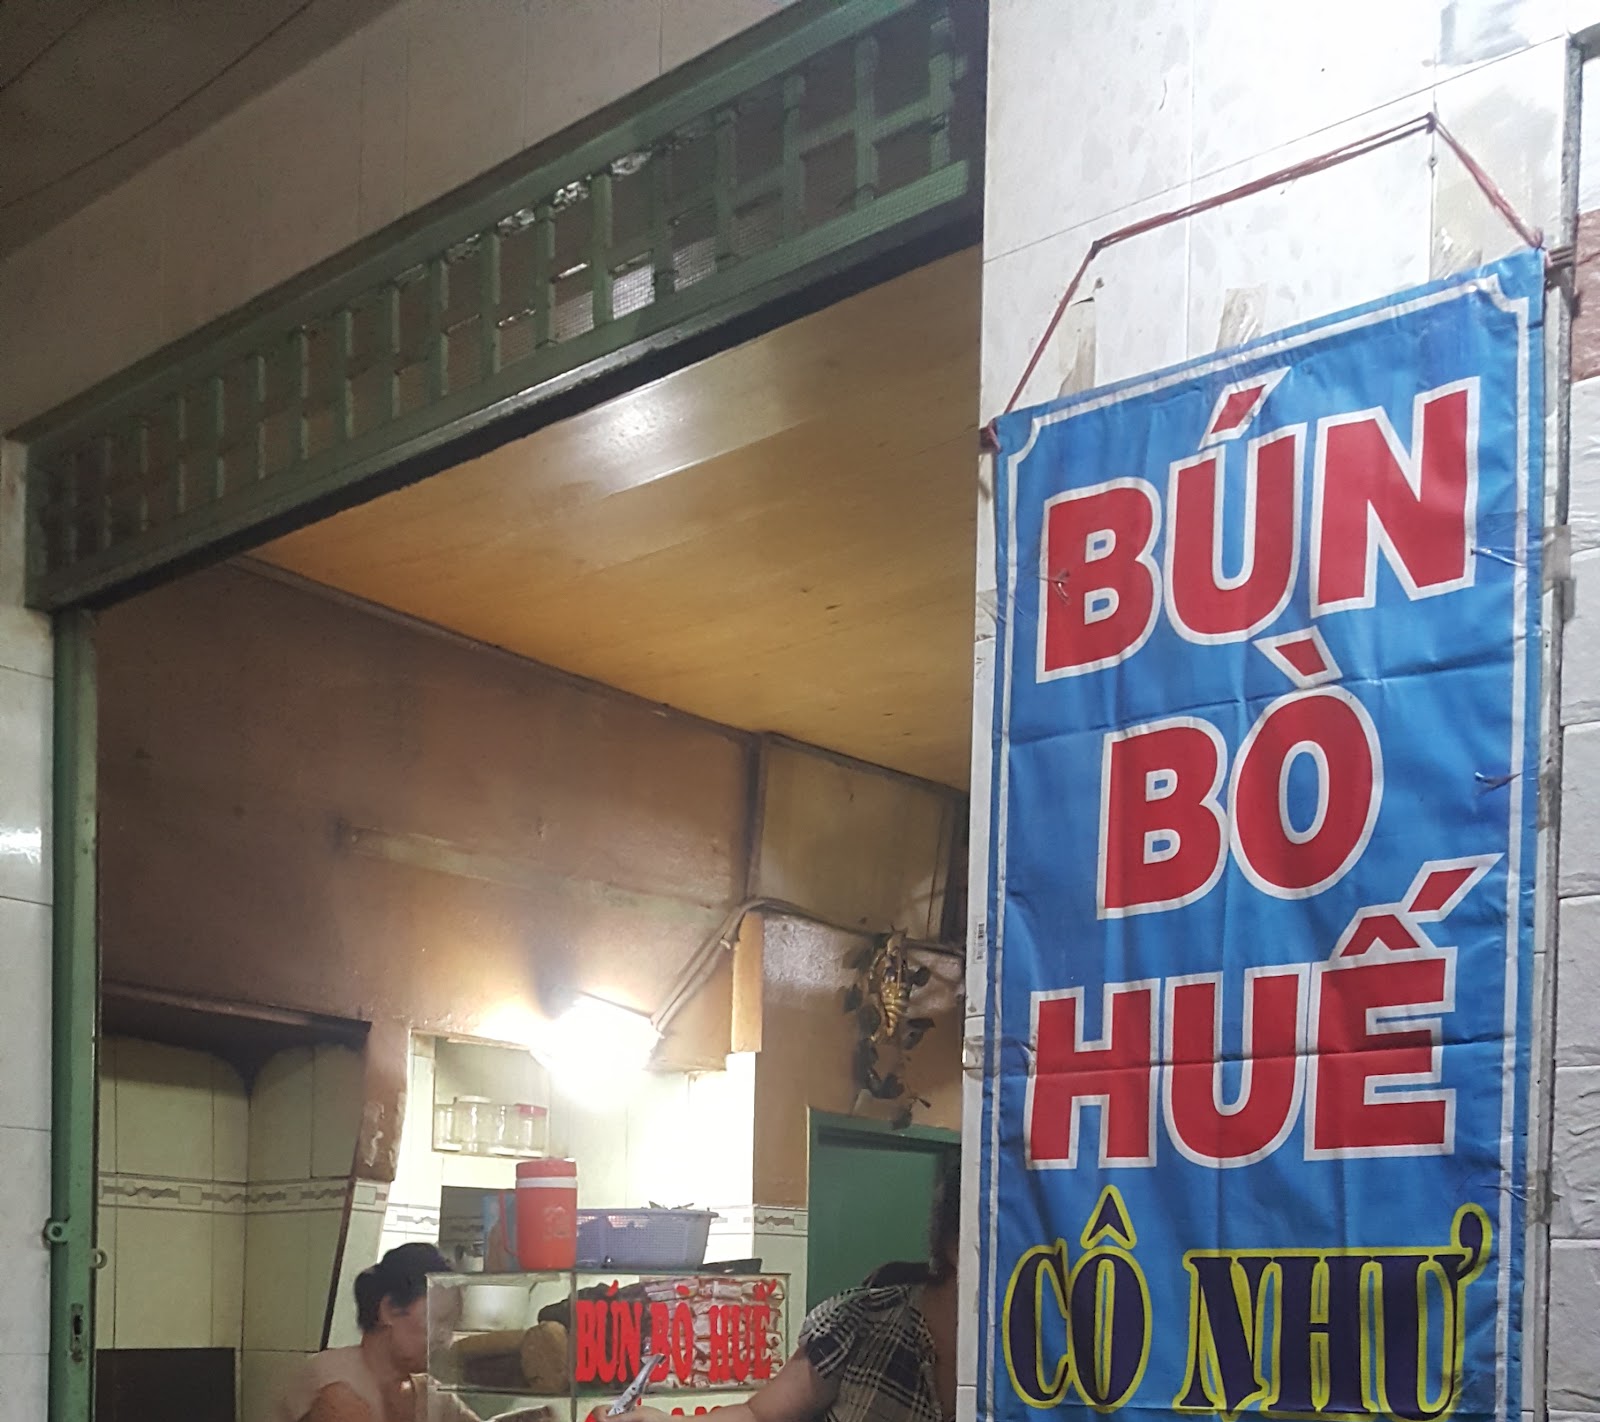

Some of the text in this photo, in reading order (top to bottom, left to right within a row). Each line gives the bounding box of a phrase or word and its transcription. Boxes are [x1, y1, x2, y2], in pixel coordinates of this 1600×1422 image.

[1035, 367, 1480, 683] BÚN
[1096, 626, 1384, 919] BÒ
[1025, 853, 1504, 1169] HUẾ
[575, 1279, 777, 1384] BÚN BÒ HUẾ
[1003, 1184, 1152, 1413] CÔ
